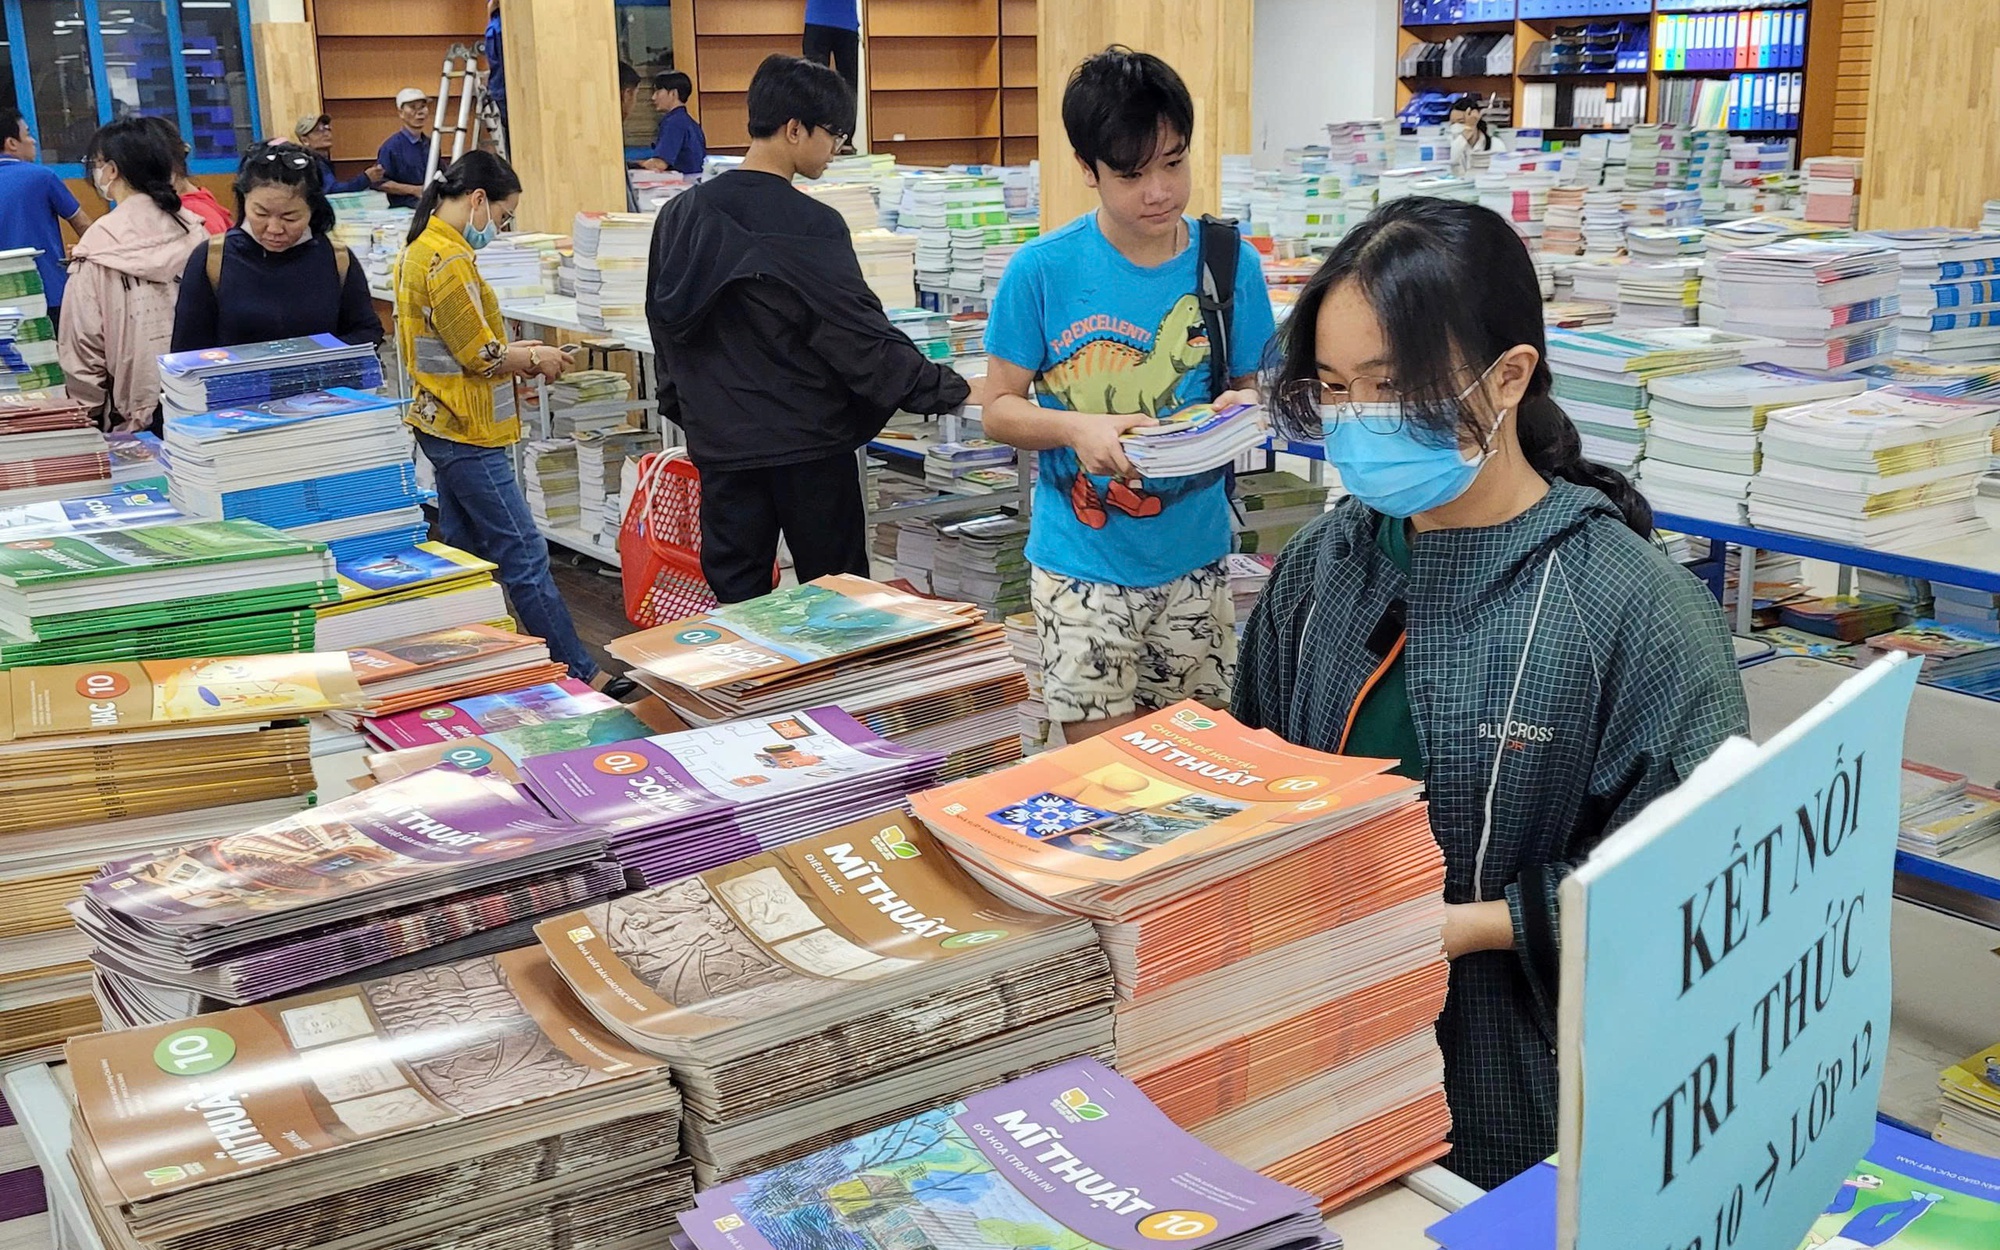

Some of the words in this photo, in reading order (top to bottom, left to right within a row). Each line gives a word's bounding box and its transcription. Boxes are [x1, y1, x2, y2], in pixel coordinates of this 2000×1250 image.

[682, 631, 712, 643] 10
[87, 675, 115, 695] 10
[426, 709, 445, 719] 10
[1150, 722, 1194, 749] CHUYÊN
[1508, 720, 1555, 742] CROSS
[451, 750, 482, 766] 10
[604, 755, 638, 772] 10
[1121, 730, 1177, 755] MĨ
[1162, 750, 1266, 786] THUẬT
[629, 775, 681, 804] HỌC
[1279, 779, 1319, 791] 10
[397, 811, 490, 847] THUẬT
[804, 853, 825, 874] ĐIÊU
[820, 870, 847, 896] KHẮC
[1677, 824, 1783, 1001] KẾT
[1789, 742, 1866, 894] NỐI
[823, 843, 883, 881] MĨ
[857, 875, 960, 939] THUẬT
[956, 932, 999, 944] 10
[168, 1035, 213, 1069] 10
[1651, 1021, 1741, 1196] TRI
[1752, 888, 1866, 1083] THỨC
[184, 1082, 265, 1149] THUẬ
[1714, 1183, 1743, 1250] 10
[1788, 1059, 1843, 1175] LỚP
[1849, 1019, 1872, 1094] 12
[213, 1141, 282, 1165] MĨ
[993, 1109, 1063, 1149] MĨ
[1035, 1141, 1156, 1216] THUẬT
[1004, 1150, 1042, 1187] (TRANH
[1038, 1175, 1057, 1194] IN)
[1153, 1214, 1205, 1237] 10
